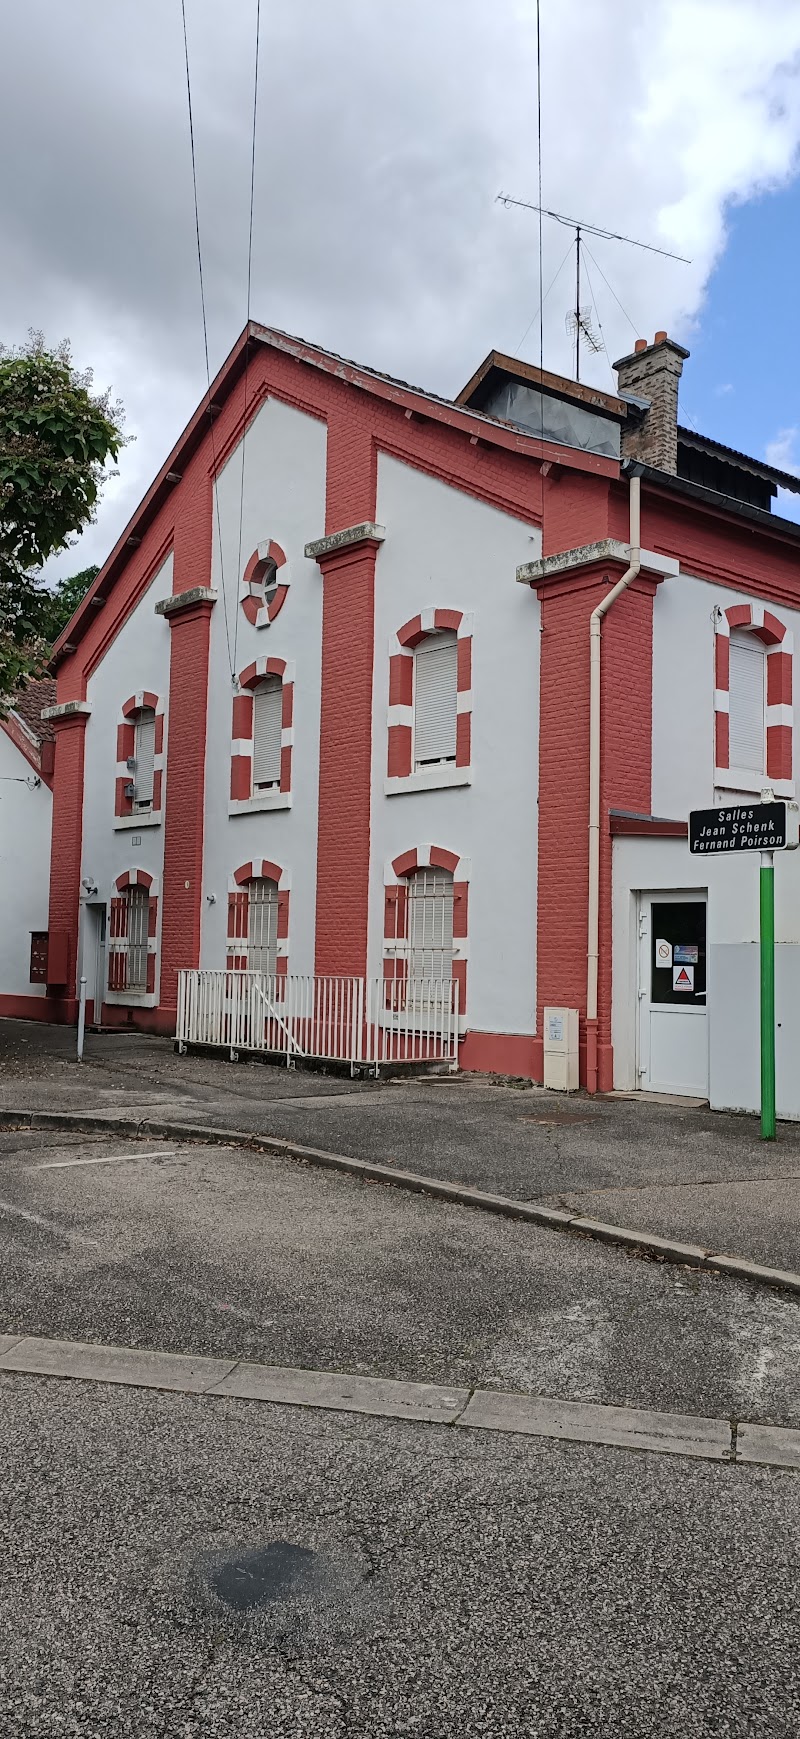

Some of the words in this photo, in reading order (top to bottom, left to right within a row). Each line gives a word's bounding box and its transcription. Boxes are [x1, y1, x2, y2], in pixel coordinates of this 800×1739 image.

[718, 809, 753, 821] Salles
[700, 826, 725, 837] Jean
[731, 820, 774, 834] Schenk
[693, 837, 735, 850] Fernand
[740, 835, 782, 847] Poirson
